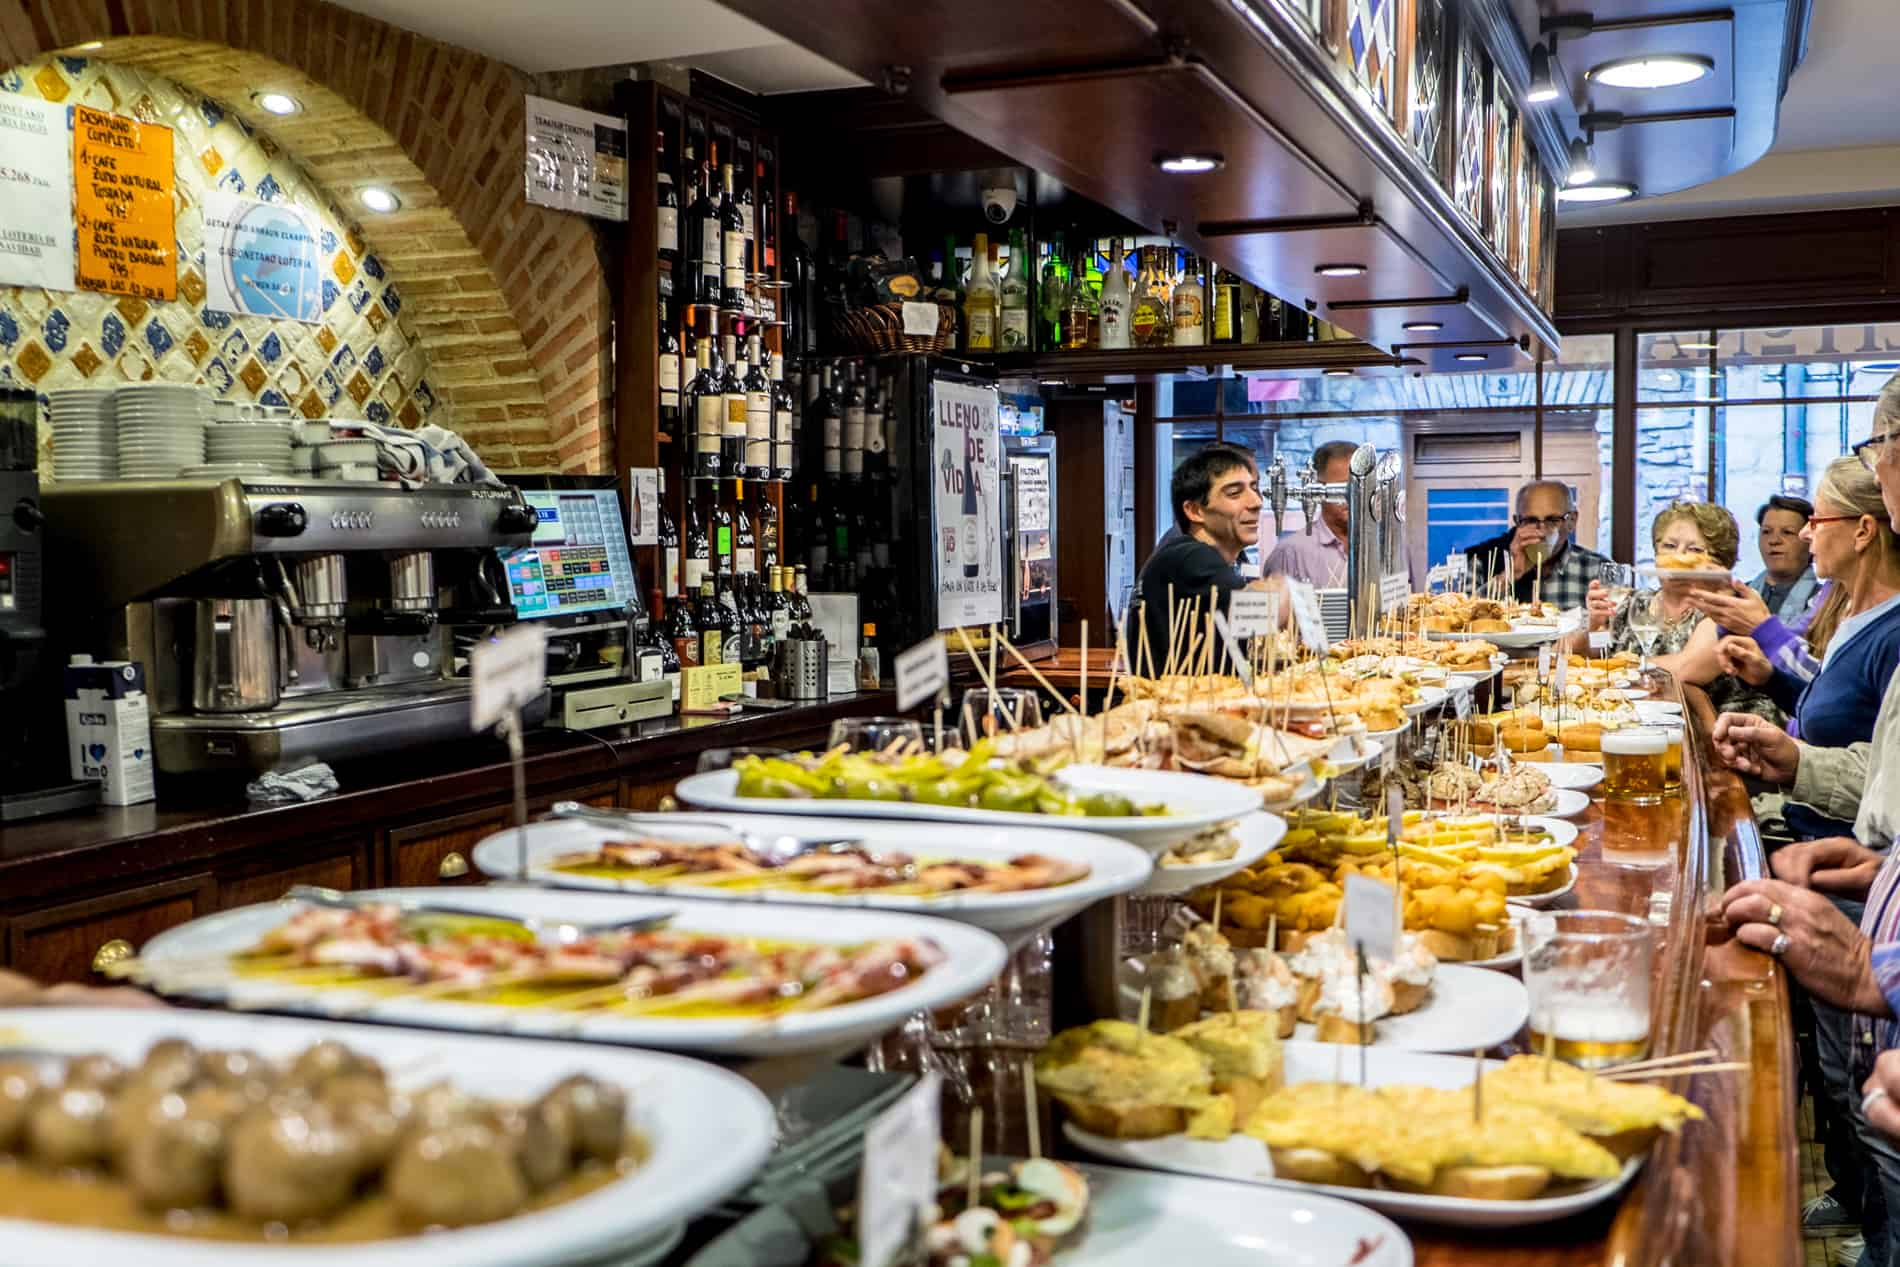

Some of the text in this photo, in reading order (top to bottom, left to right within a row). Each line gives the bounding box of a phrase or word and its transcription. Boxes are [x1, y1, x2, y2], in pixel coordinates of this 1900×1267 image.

[87, 127, 135, 149] COMPLETO
[121, 175, 163, 192] NATURAL
[121, 235, 158, 250] NATURAL
[1498, 377, 1508, 392] 8
[940, 400, 979, 430] LLENO
[968, 437, 984, 463] DE
